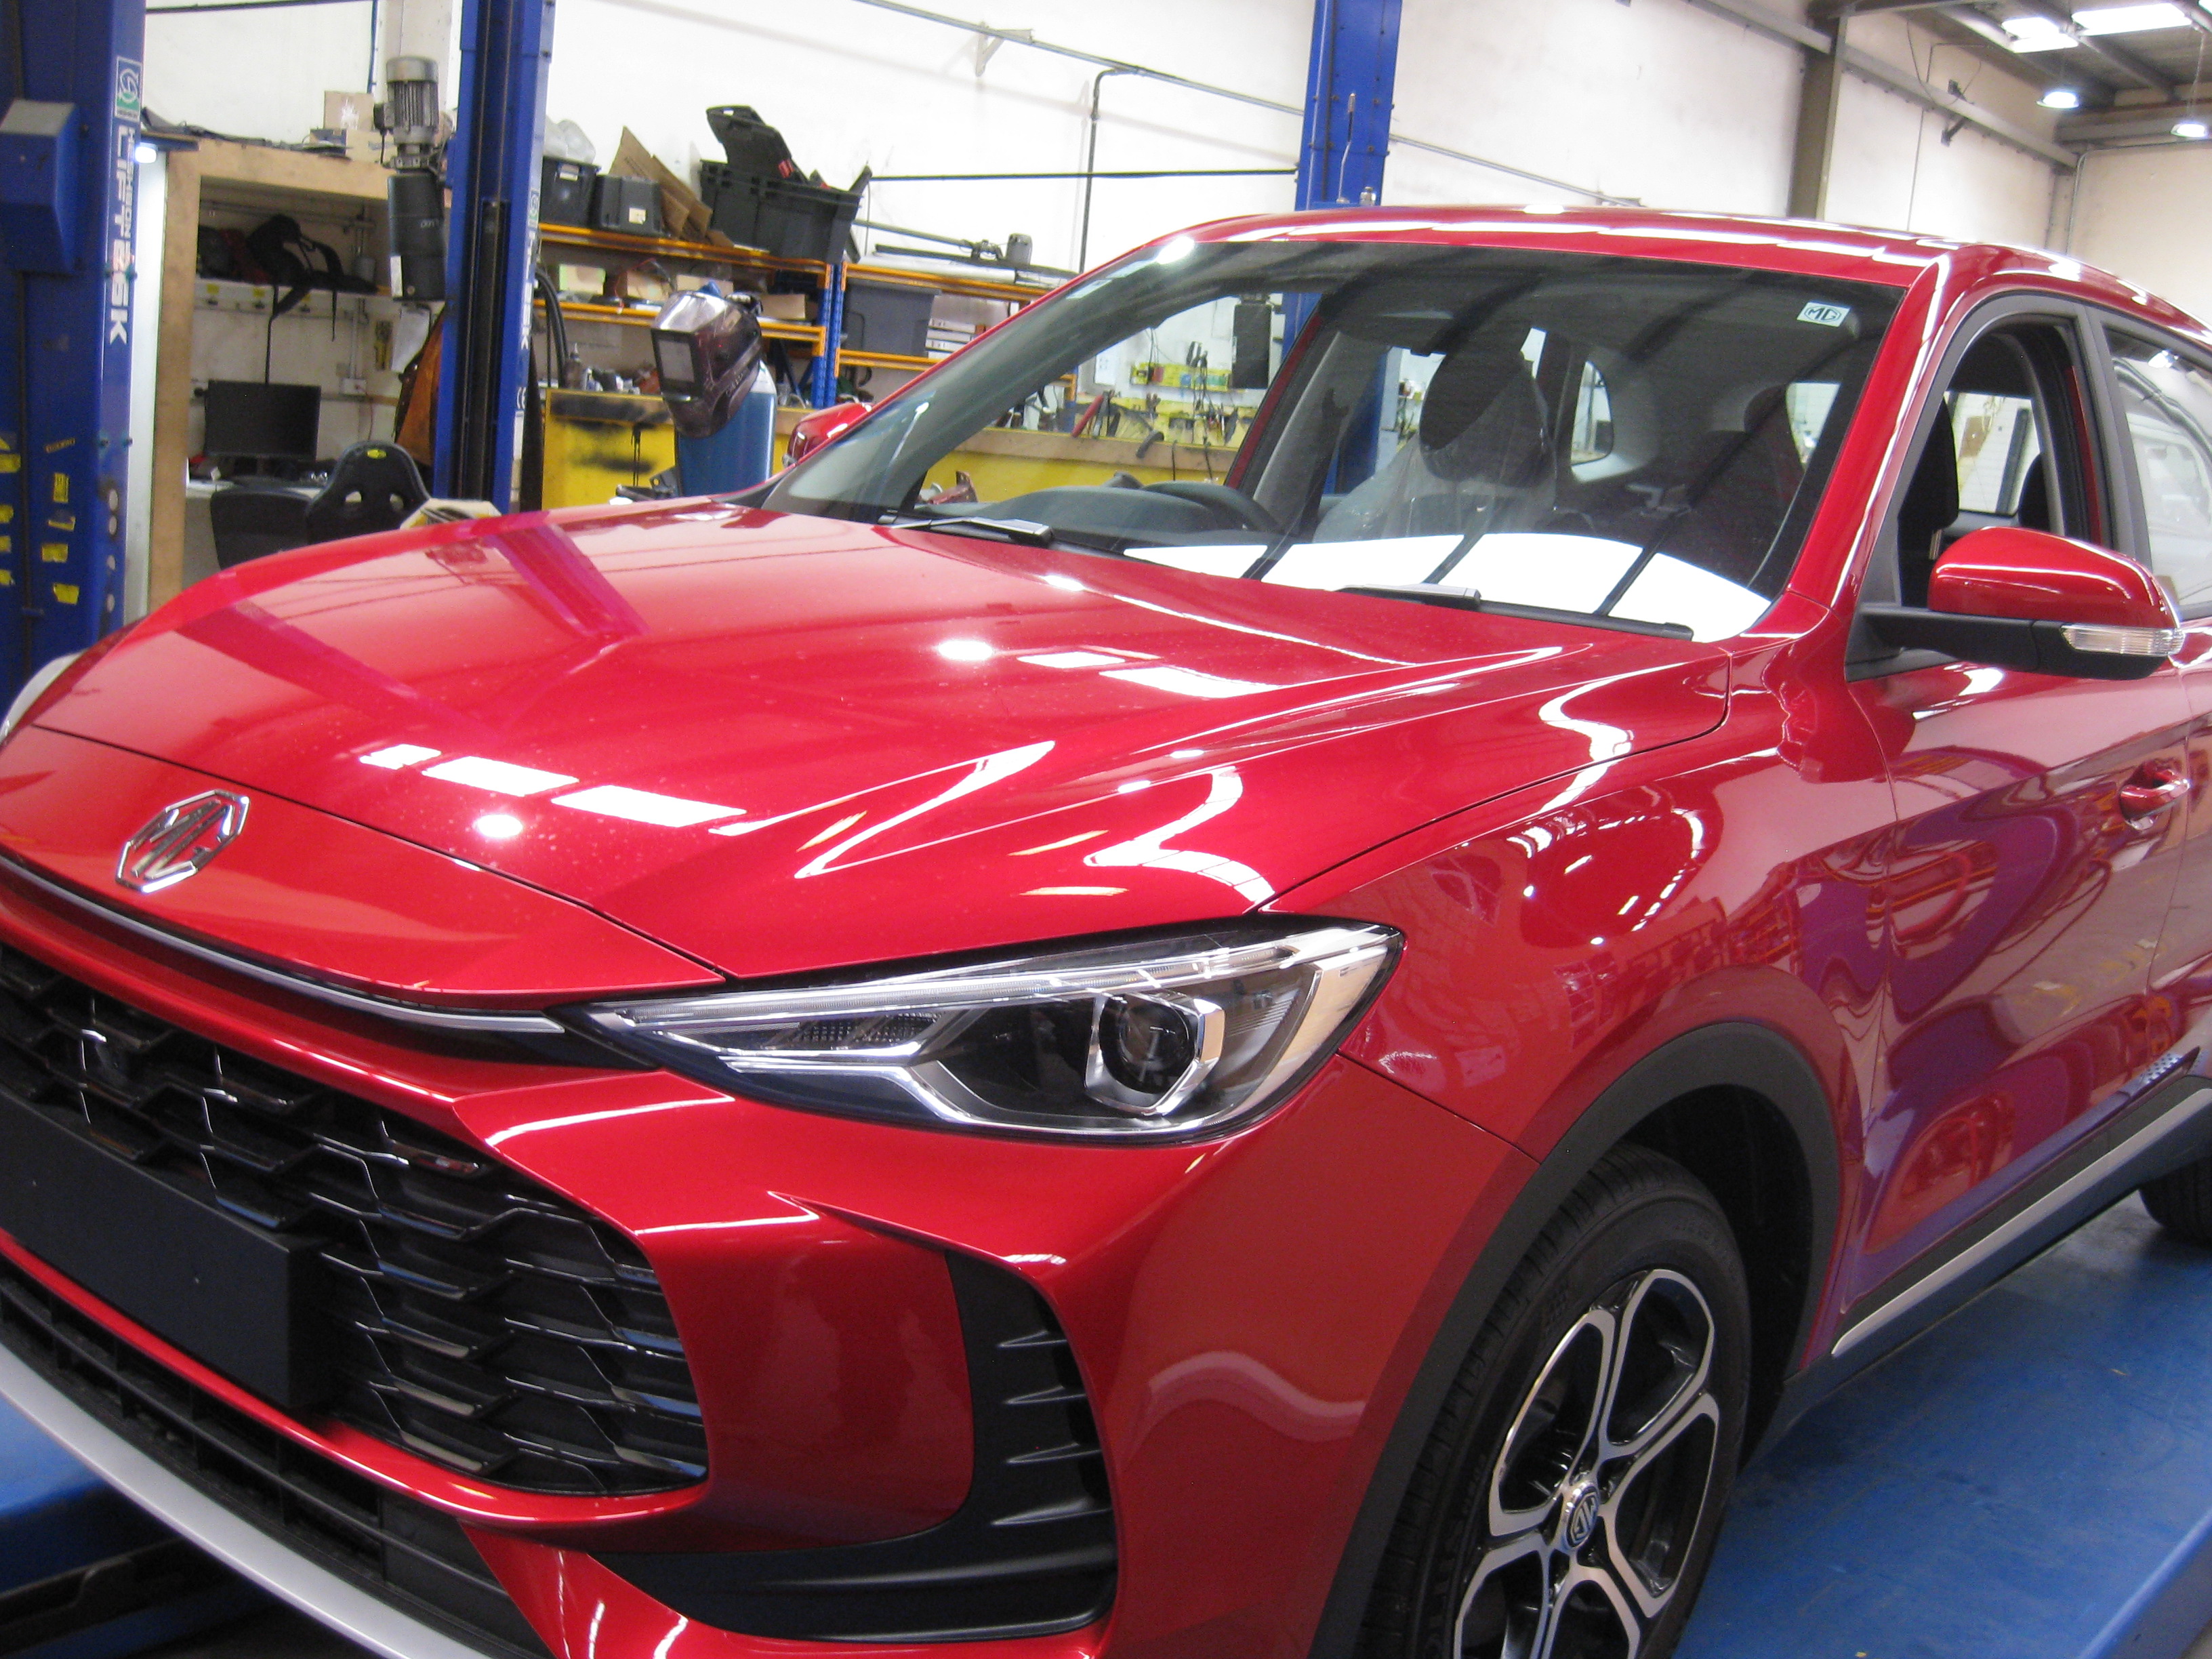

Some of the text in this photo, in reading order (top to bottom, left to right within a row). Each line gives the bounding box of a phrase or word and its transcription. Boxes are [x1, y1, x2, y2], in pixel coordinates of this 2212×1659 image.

[114, 125, 129, 237] LIFT
[1807, 307, 1838, 321] MG
[127, 796, 239, 882] MG
[1572, 1495, 1597, 1539] MG
